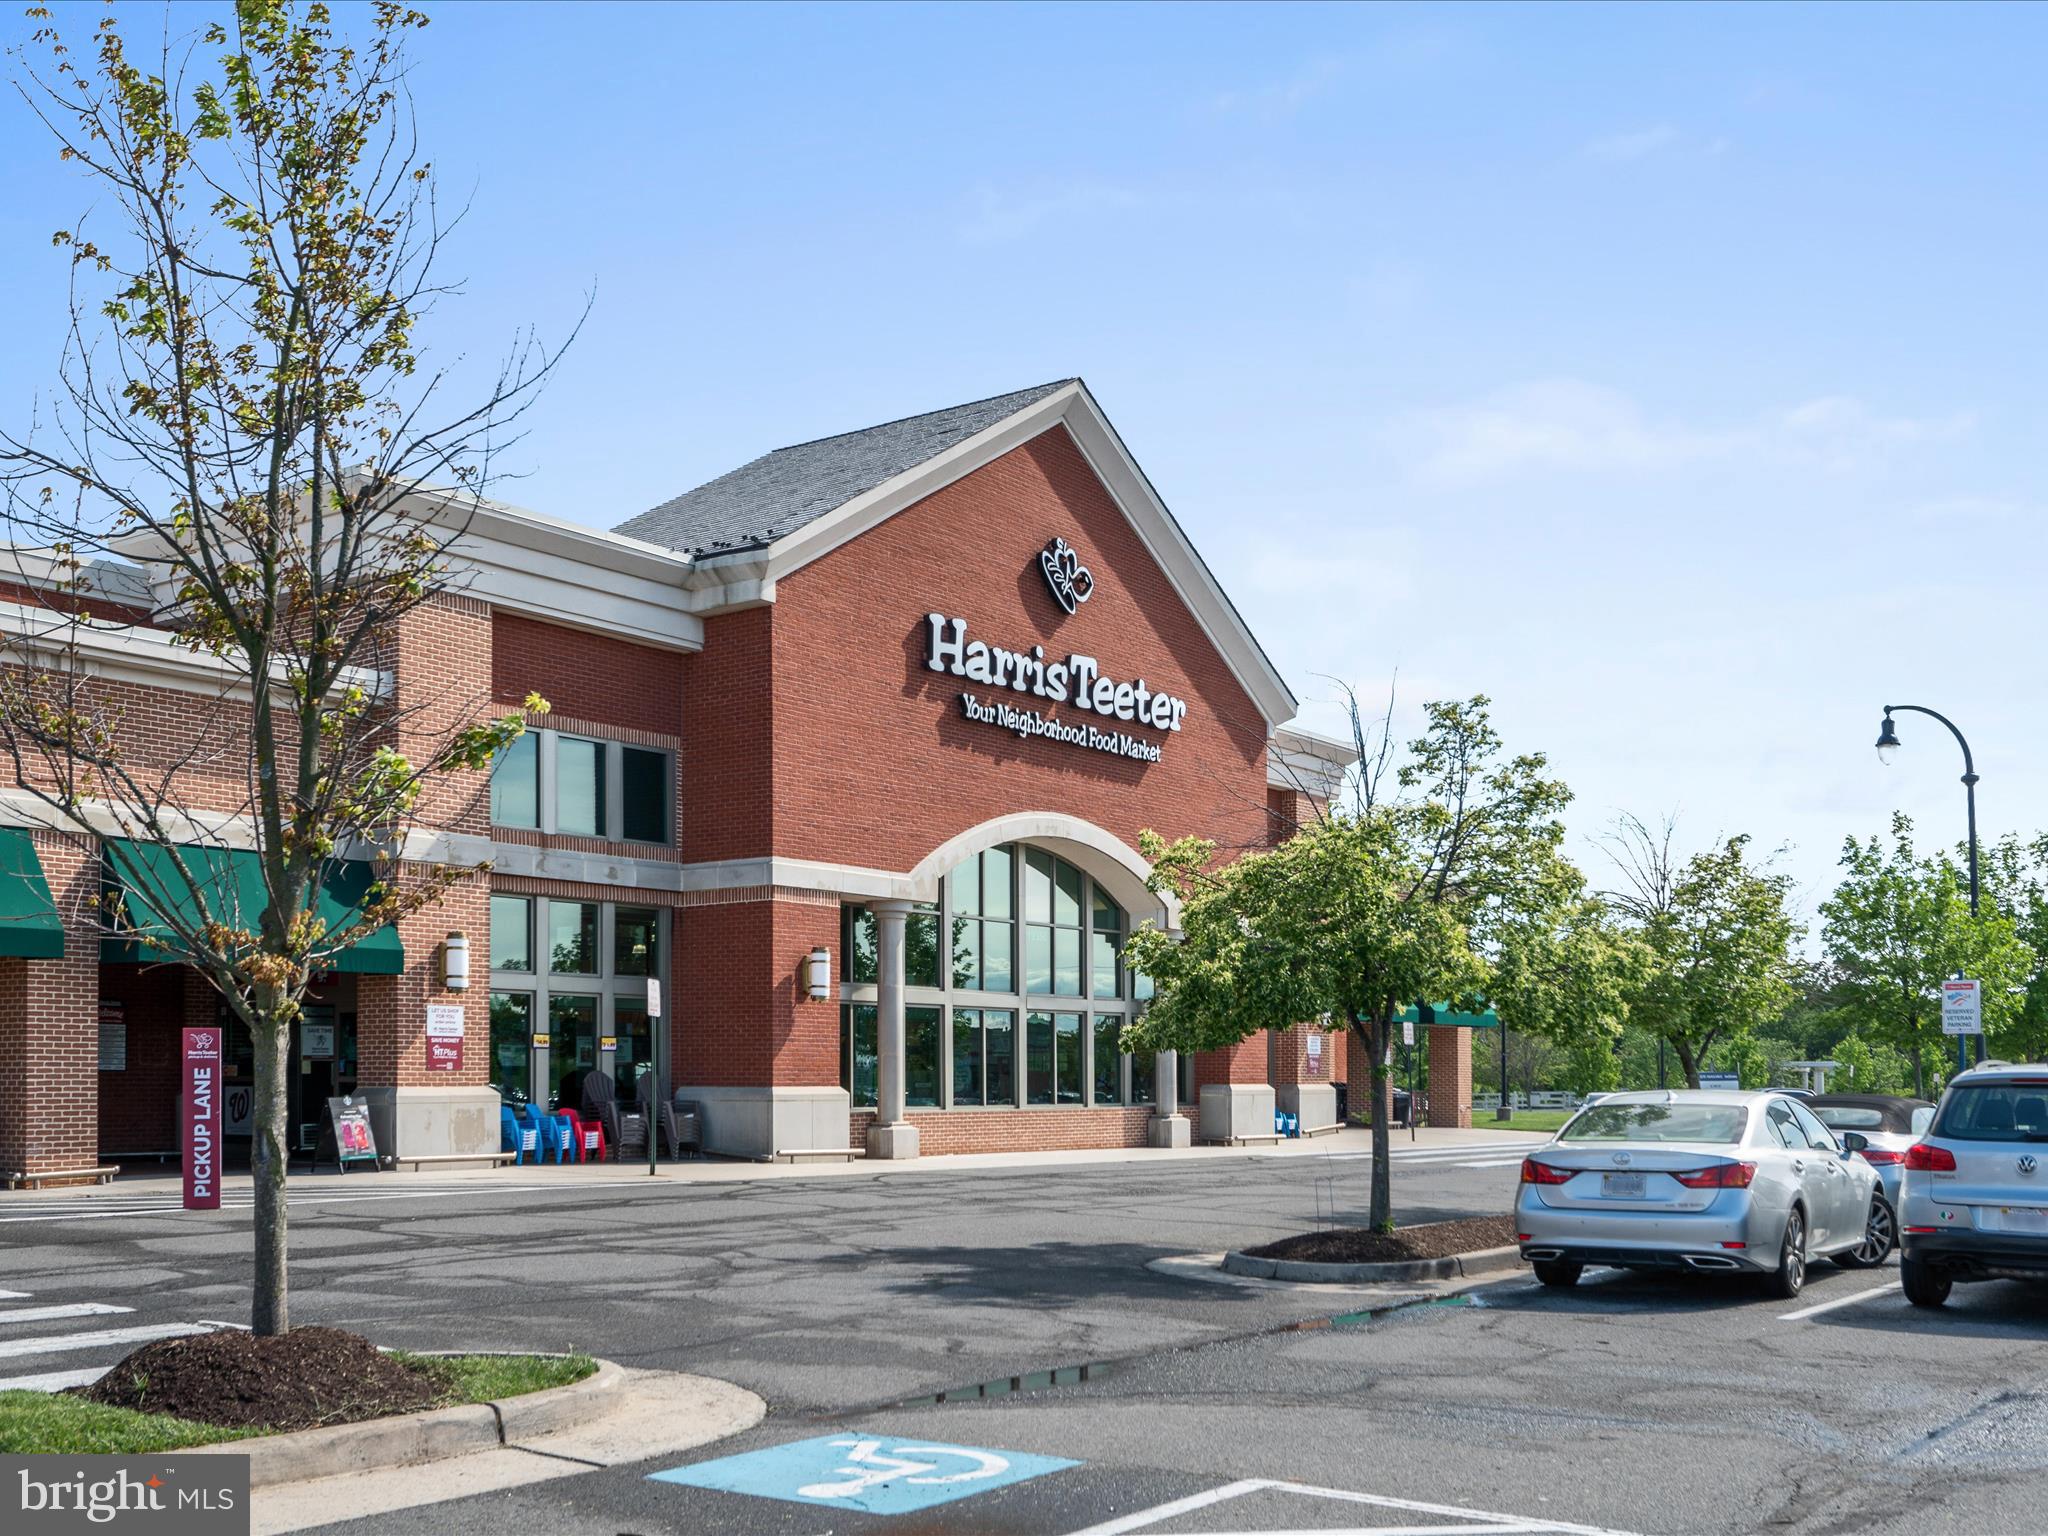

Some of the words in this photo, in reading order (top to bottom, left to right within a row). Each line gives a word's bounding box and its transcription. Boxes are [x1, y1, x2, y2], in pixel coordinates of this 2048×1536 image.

[961, 692, 997, 724] Your
[997, 703, 1087, 747] Neighborhood
[1088, 726, 1119, 755] Food
[1119, 735, 1162, 763] Market
[193, 1067, 211, 1120] LANE
[193, 1124, 211, 1198] PICKUP
